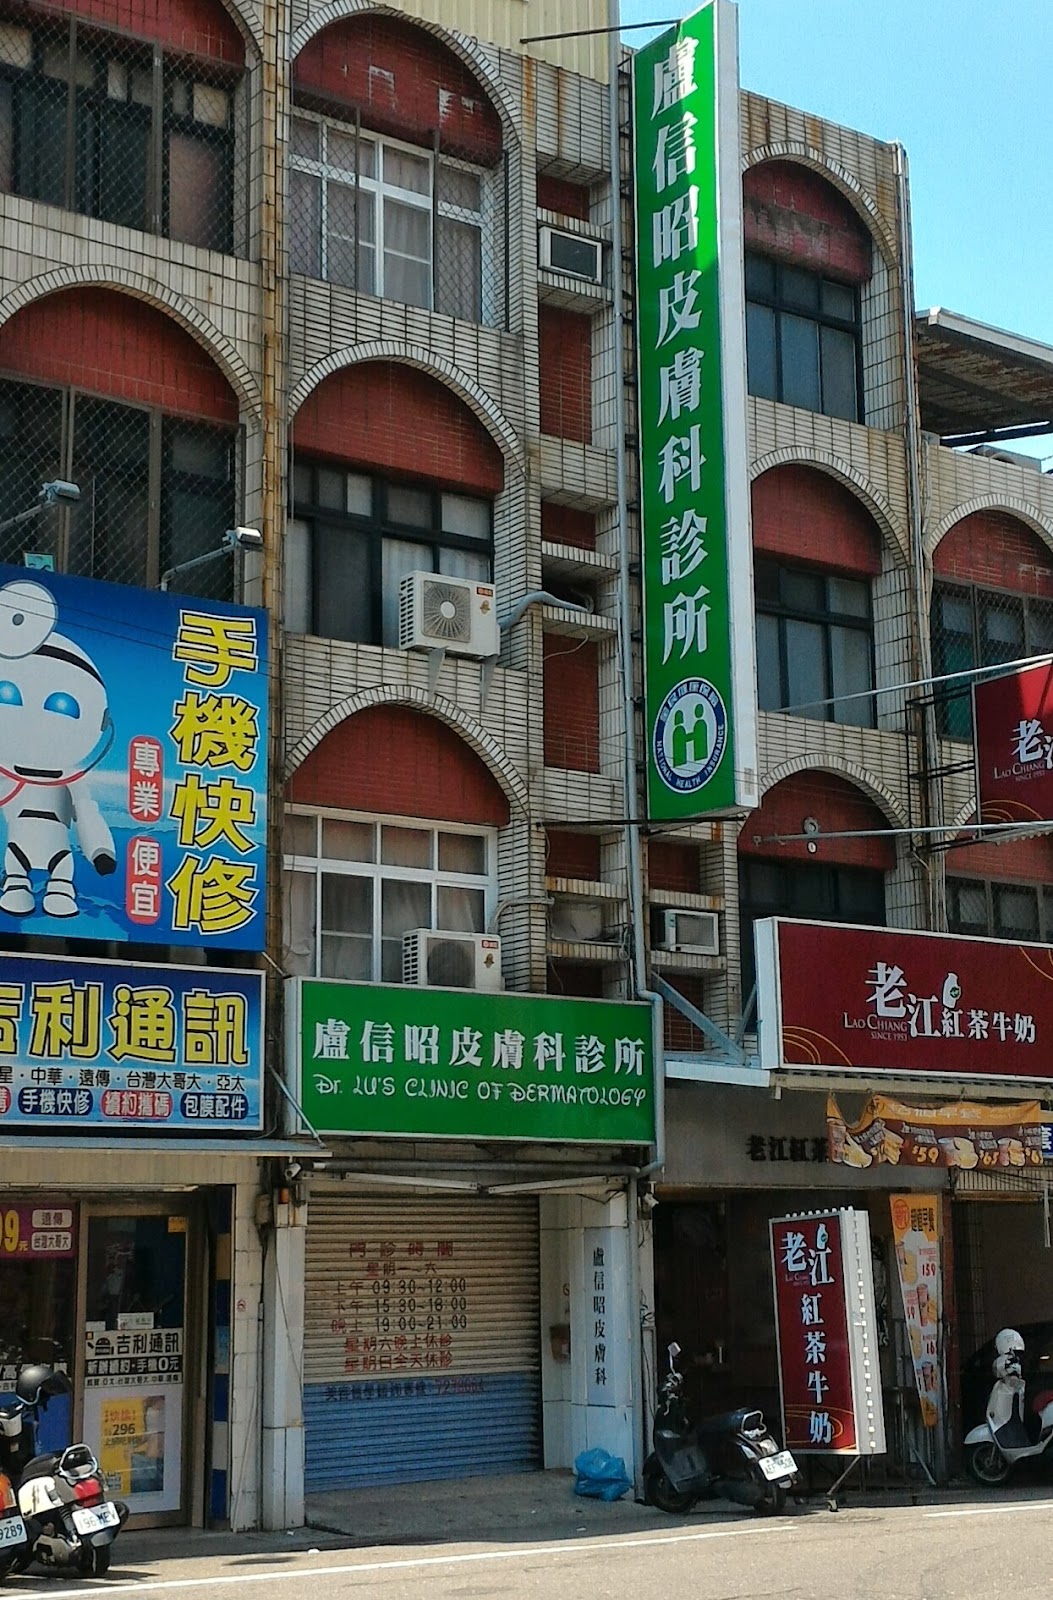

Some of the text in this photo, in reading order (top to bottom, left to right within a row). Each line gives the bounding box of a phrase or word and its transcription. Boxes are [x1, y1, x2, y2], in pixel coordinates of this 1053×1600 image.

[651, 36, 711, 665] 盧信昭皮膚科診所
[133, 741, 160, 817] 專業
[168, 609, 259, 934] 手機快修
[656, 740, 673, 781] NATIONAL
[675, 777, 701, 788] HEALTH
[703, 724, 724, 776] INSURANCE
[131, 841, 159, 917] 便宜
[313, 1018, 646, 1076] 盧信昭皮膚科診所
[871, 1031, 892, 1040] SINCE
[22, 1088, 90, 1115] 手機快修
[183, 1094, 246, 1119] 包膜配件
[405, 1077, 469, 1100] CLINIC
[477, 1081, 503, 1099] OF
[509, 1082, 646, 1107] DERMATOLOGY
[911, 1145, 939, 1163] $59
[116, 1332, 179, 1354] 吉利通訊
[593, 1247, 607, 1386] 盧信昭皮膚科
[800, 1293, 833, 1444] 紅茶牛奶
[112, 1423, 136, 1436] 296
